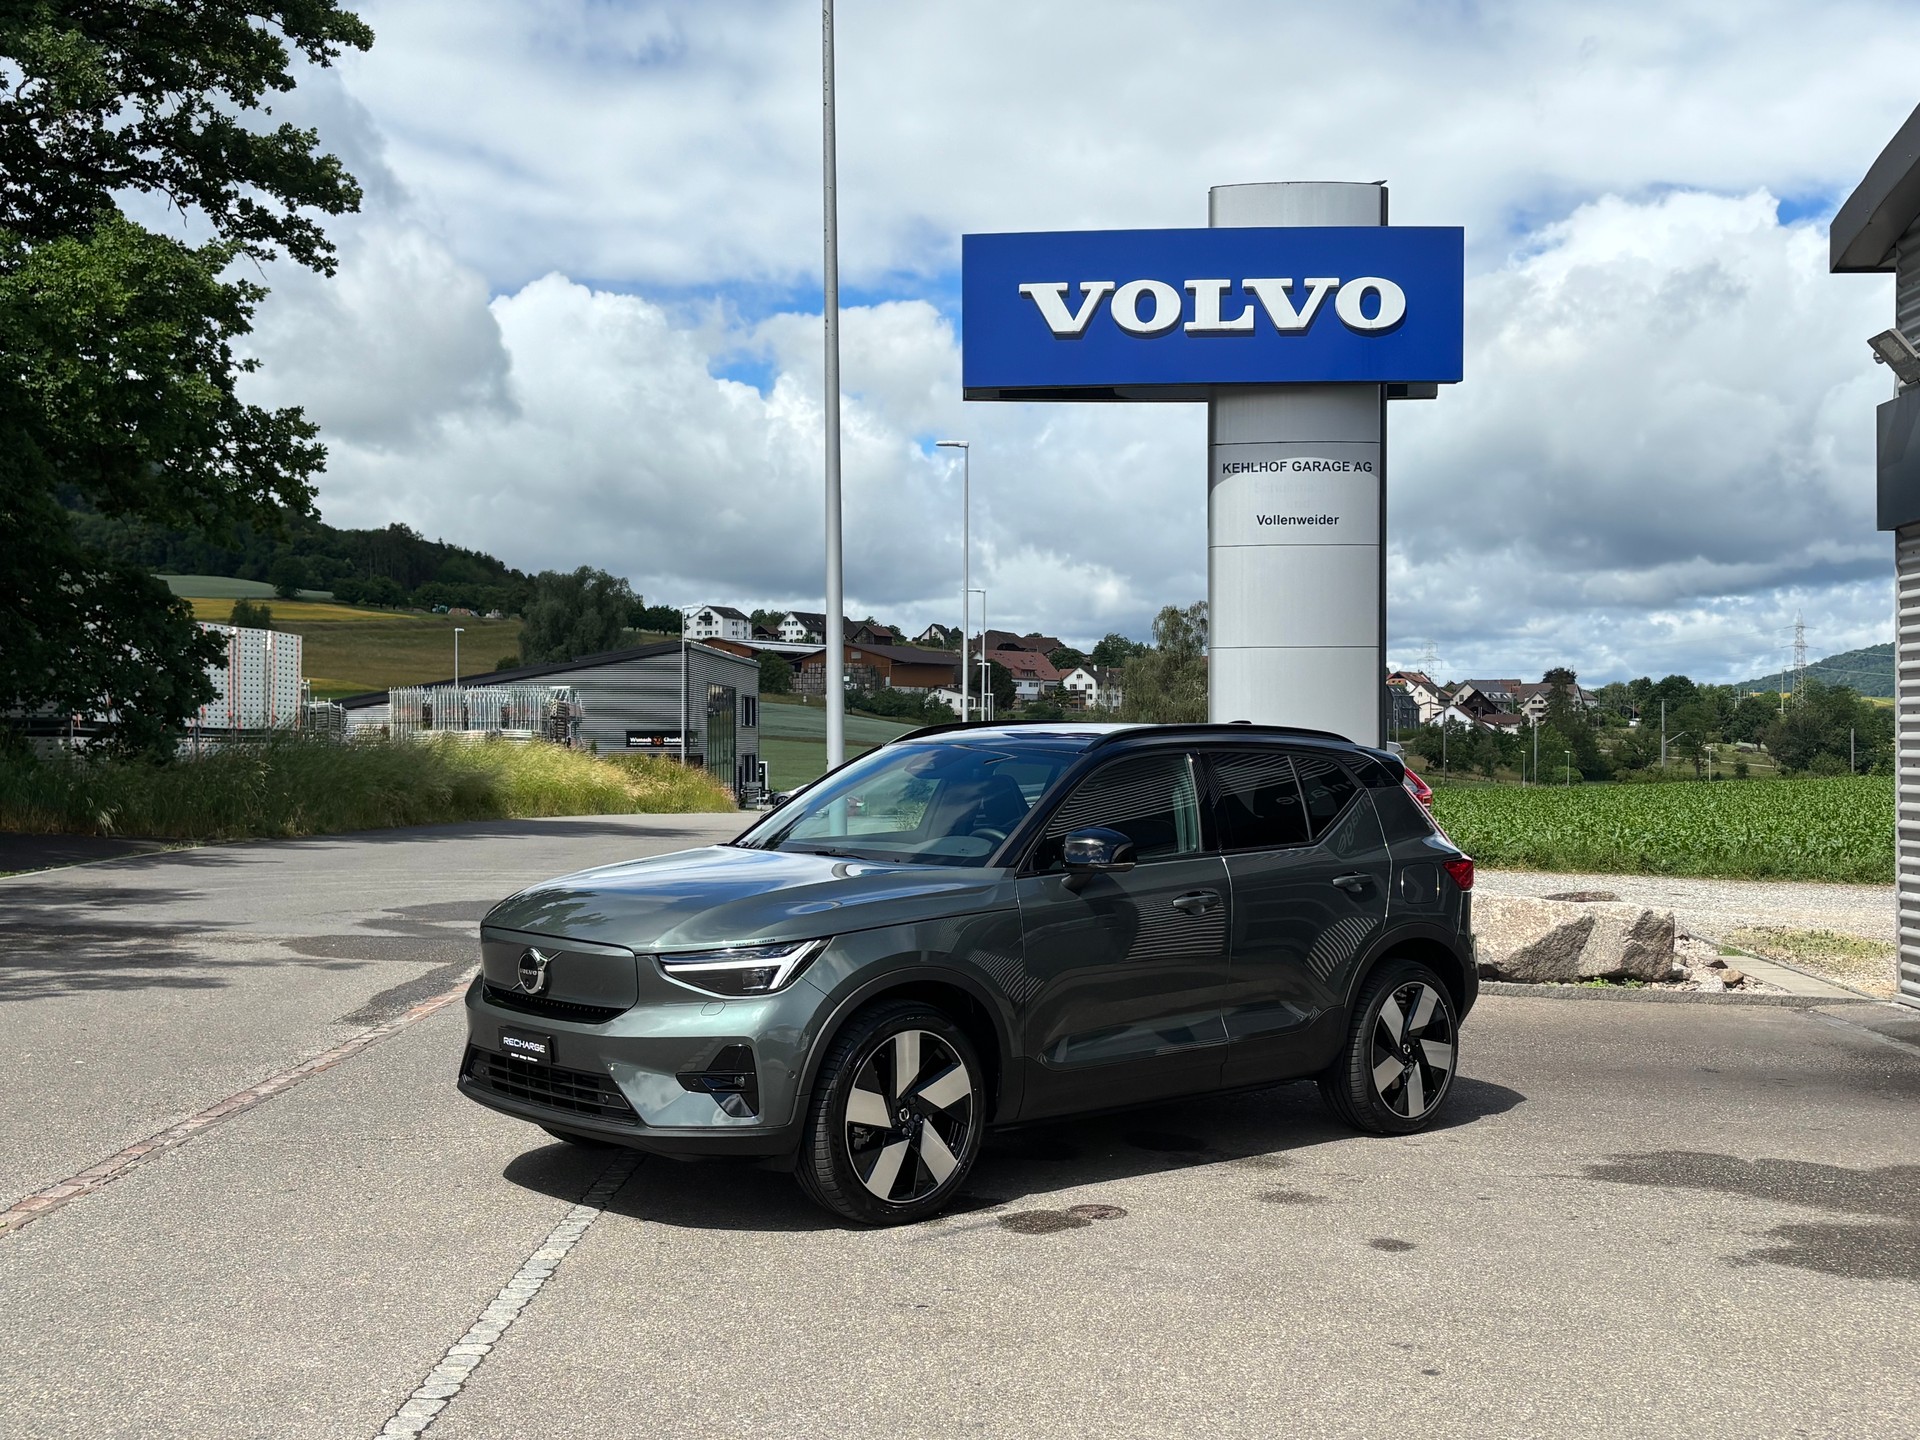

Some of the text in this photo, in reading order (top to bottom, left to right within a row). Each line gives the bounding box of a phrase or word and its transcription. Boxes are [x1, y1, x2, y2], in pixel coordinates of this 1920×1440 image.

[1019, 276, 1406, 333] VOLVO
[1222, 460, 1373, 474] KEHLHOF GARAGE AG
[1256, 514, 1340, 526] Vollenweider
[503, 1036, 546, 1053] RECHARGE
